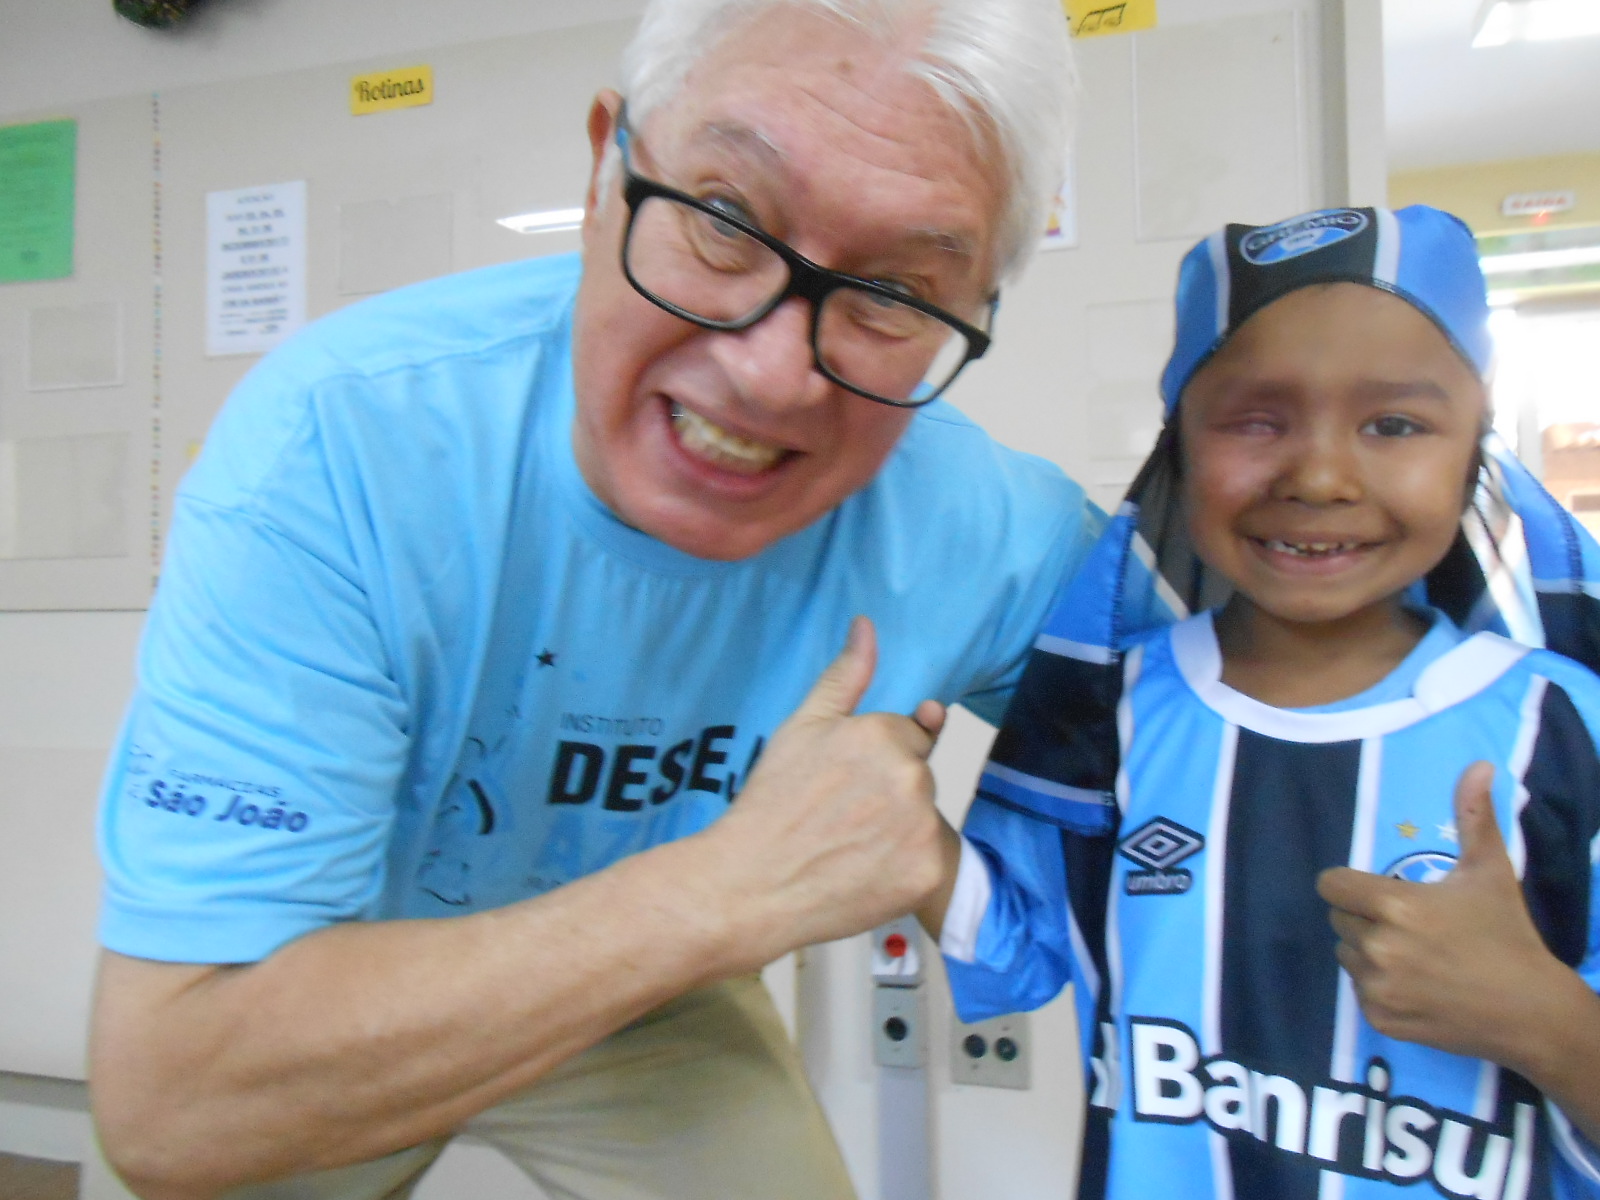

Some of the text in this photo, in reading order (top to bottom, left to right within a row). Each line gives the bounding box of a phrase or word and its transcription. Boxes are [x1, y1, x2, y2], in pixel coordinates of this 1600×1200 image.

[355, 78, 424, 102] Rotinas
[560, 712, 664, 736] INSTITUTO
[146, 779, 308, 833] São João
[1126, 871, 1190, 891] umbro
[1130, 1022, 1537, 1200] Banrisul
